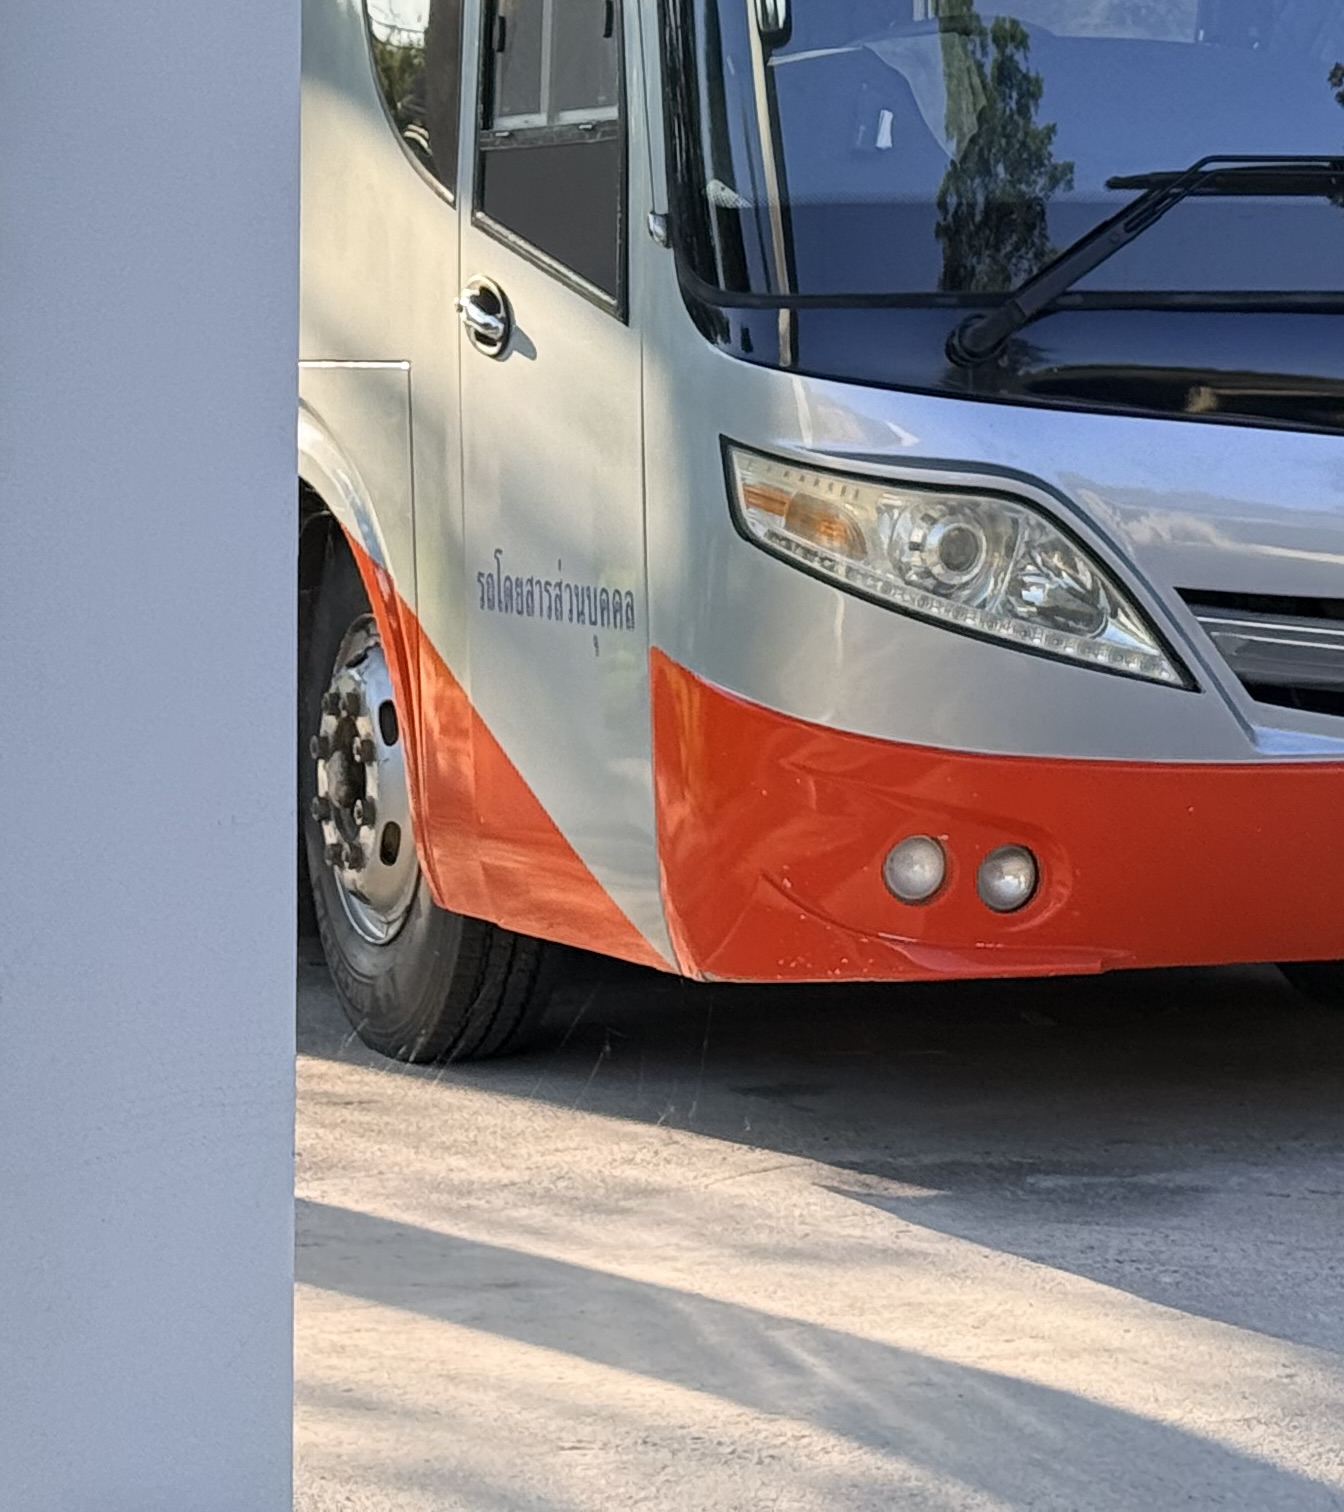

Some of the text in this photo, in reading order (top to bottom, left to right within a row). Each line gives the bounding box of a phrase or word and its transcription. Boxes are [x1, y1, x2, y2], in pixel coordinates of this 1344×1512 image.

[476, 548, 635, 657] รถโดยสารส่วนบุคคล
